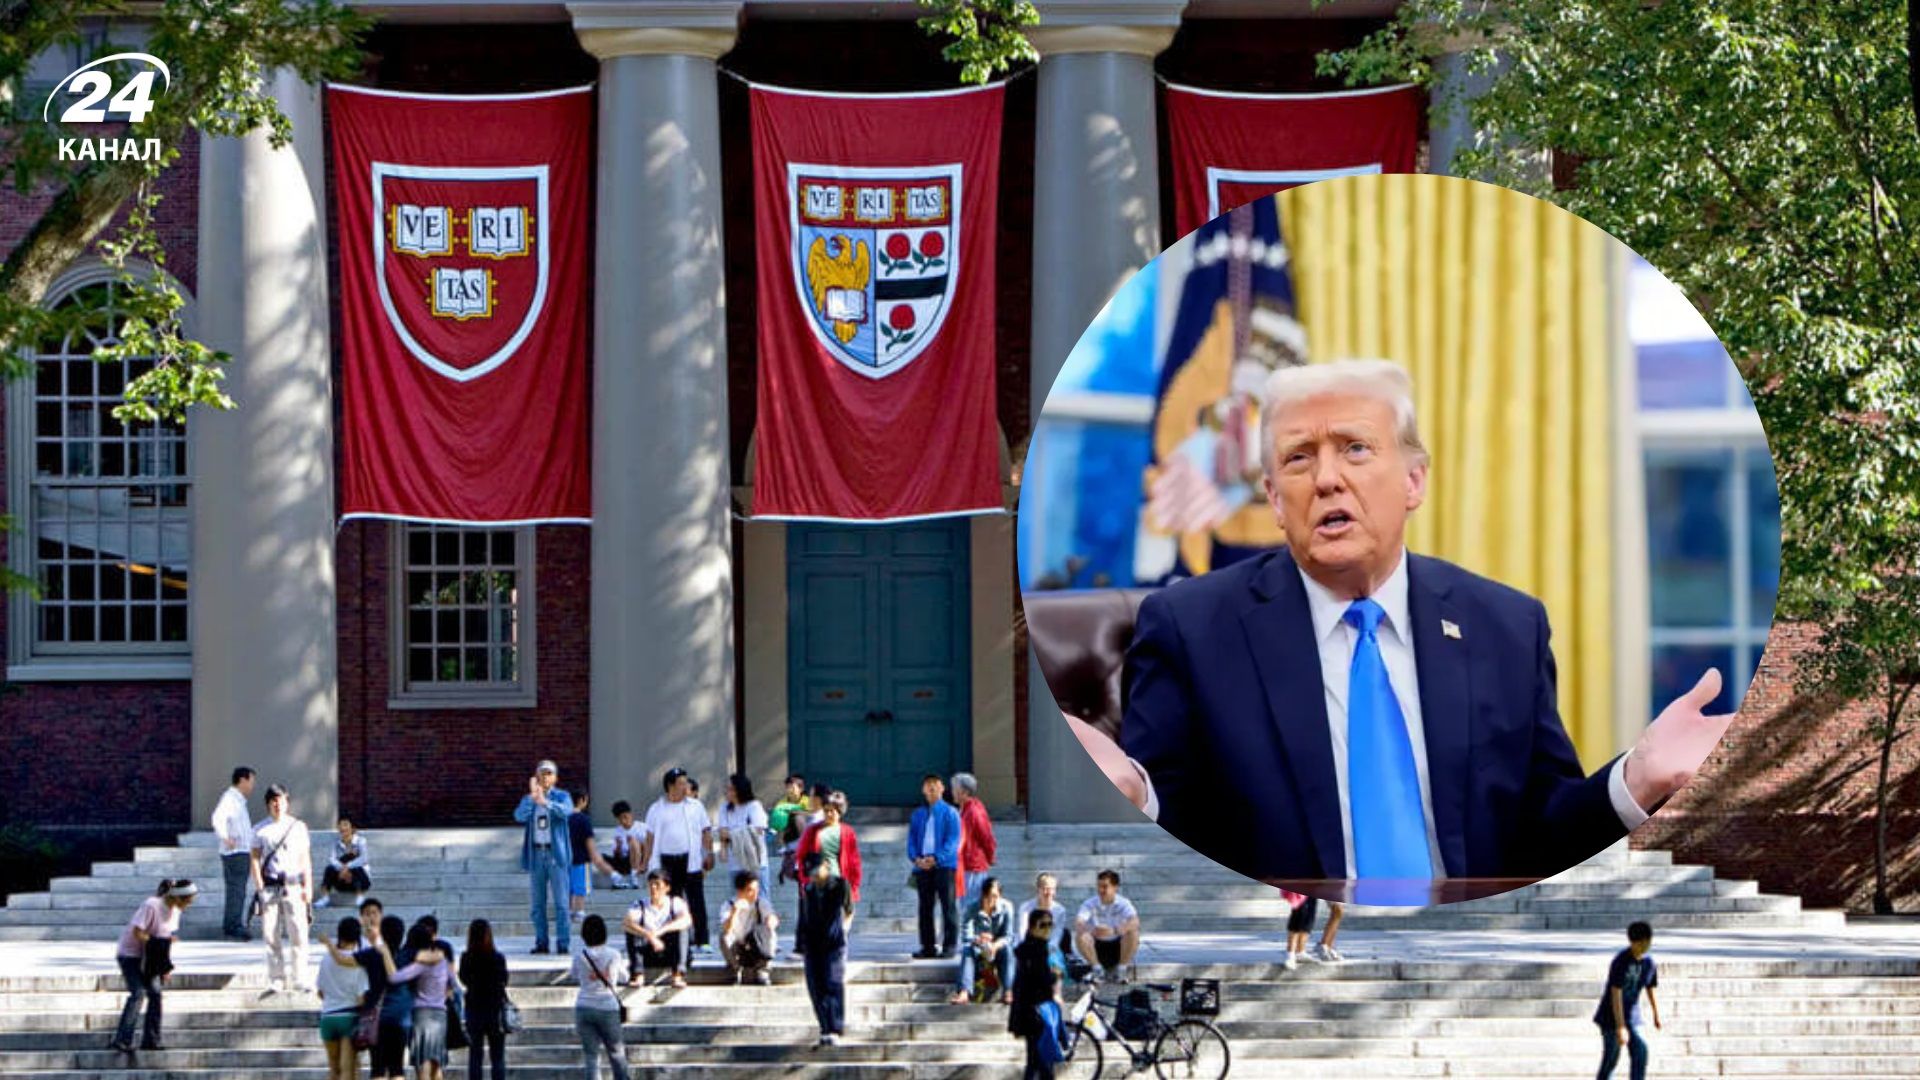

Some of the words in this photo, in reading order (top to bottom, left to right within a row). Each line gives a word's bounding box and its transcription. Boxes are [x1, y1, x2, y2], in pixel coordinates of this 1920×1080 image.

[809, 190, 837, 208] VE
[862, 193, 885, 209] RI
[911, 192, 938, 209] TAS
[404, 213, 441, 238] VE
[480, 216, 513, 239] RI
[442, 277, 481, 300] TAS
